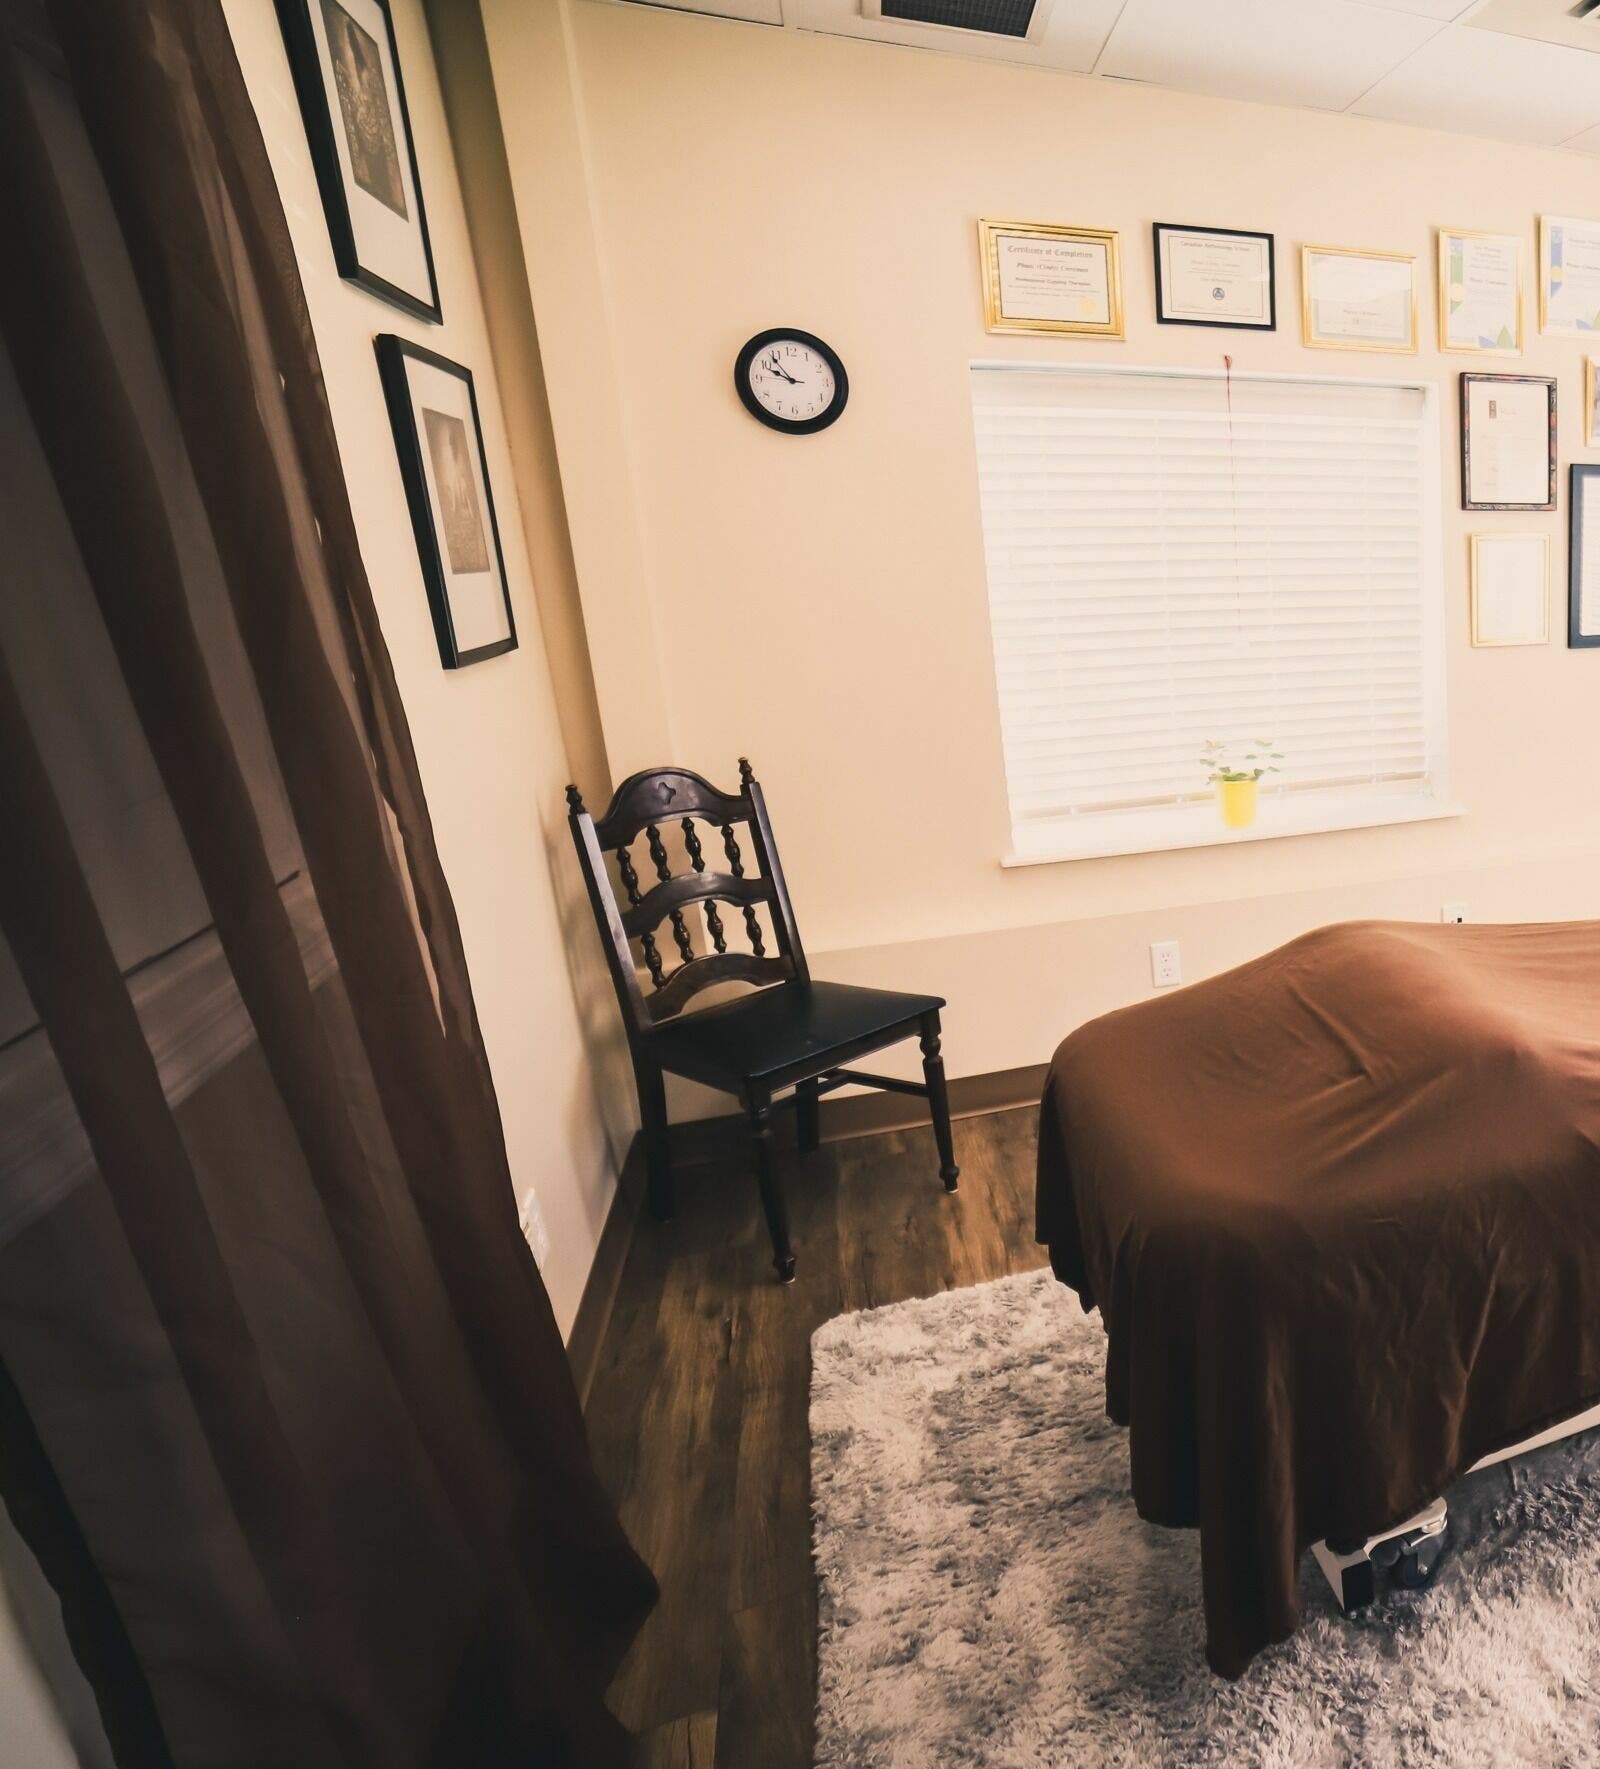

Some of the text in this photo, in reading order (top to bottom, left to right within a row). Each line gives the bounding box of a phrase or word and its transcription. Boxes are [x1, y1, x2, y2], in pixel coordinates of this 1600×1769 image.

[1007, 245, 1043, 255] Certificate
[1054, 248, 1093, 258] Completion
[786, 346, 797, 357] 12
[762, 360, 772, 370] 10
[815, 362, 822, 374] 2
[755, 374, 763, 384] 9
[776, 400, 782, 411] 7
[792, 404, 799, 414] 6
